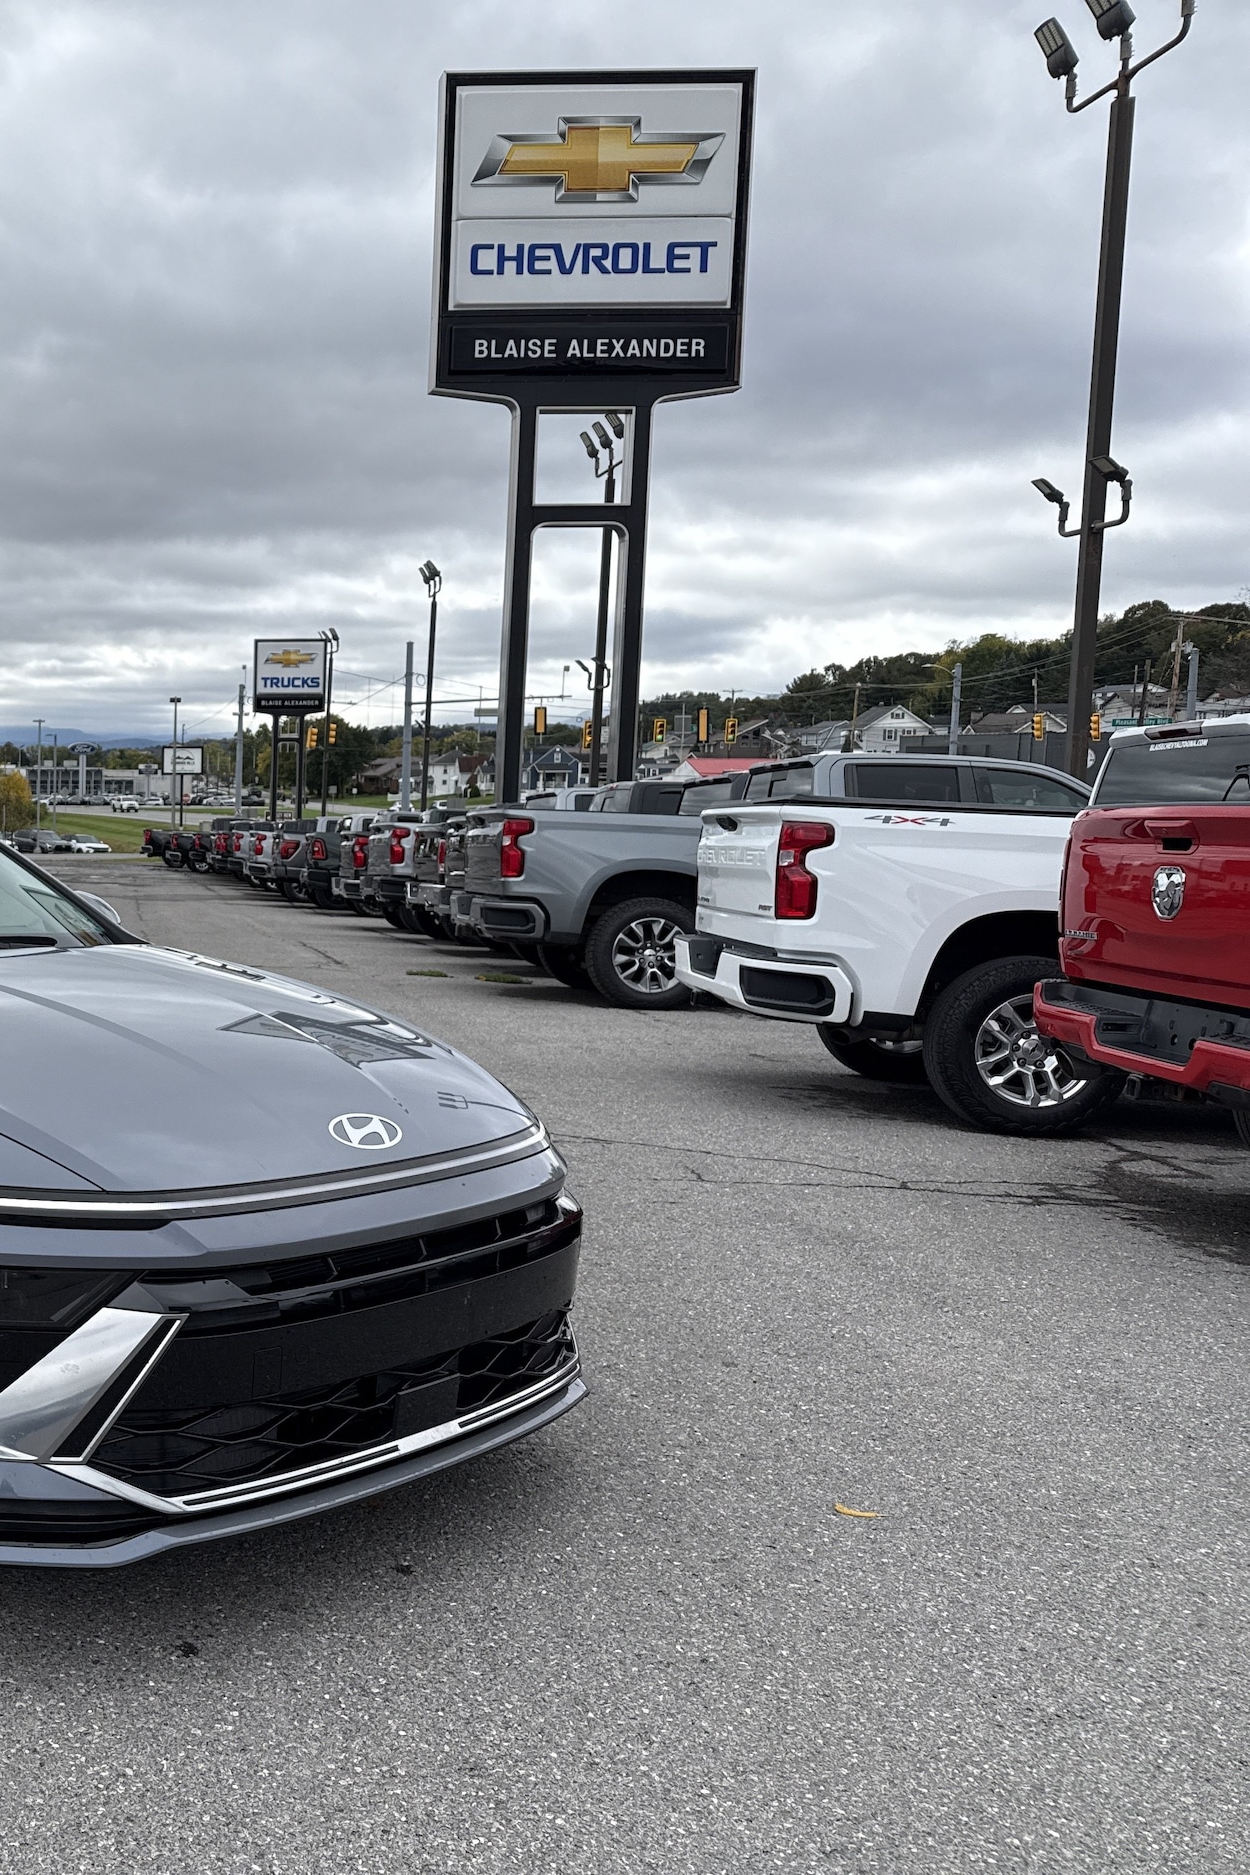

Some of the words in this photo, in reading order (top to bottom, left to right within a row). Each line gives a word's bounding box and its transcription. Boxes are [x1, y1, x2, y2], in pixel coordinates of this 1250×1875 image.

[469, 240, 718, 276] CHEVROLET
[473, 338, 558, 360] BLAISE
[566, 337, 706, 359] ALEXANDER
[261, 676, 320, 689] TRUCKS
